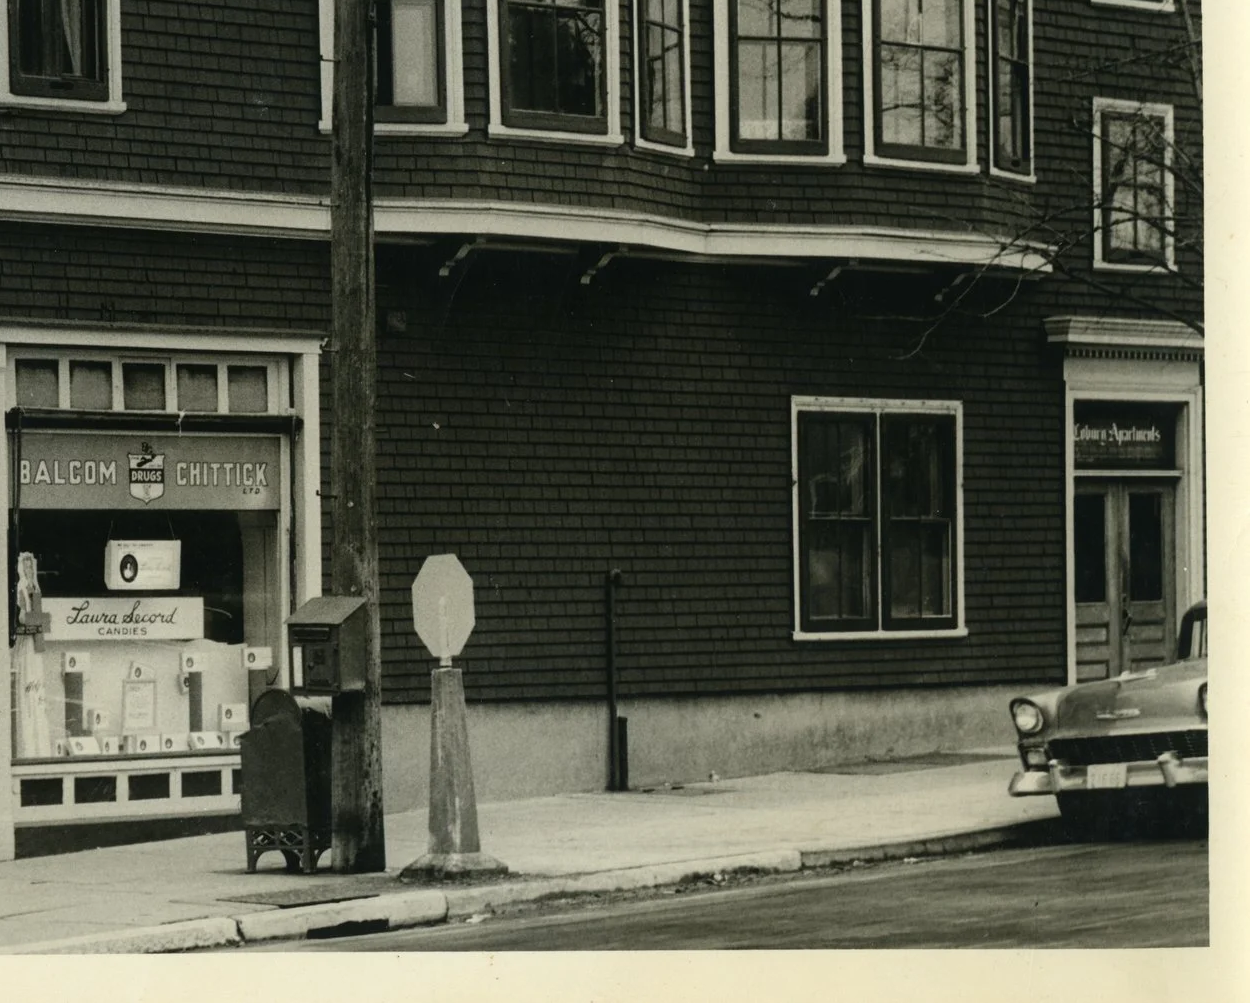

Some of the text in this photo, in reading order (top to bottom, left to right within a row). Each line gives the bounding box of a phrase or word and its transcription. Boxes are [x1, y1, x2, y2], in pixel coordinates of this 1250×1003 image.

[1108, 422, 1161, 446] Apartments
[20, 459, 117, 486] BALCOM
[131, 470, 162, 482] DRUGS
[176, 461, 268, 487] CHITTICK
[66, 600, 178, 624] Laura Secord
[97, 627, 148, 636] CANDIES
